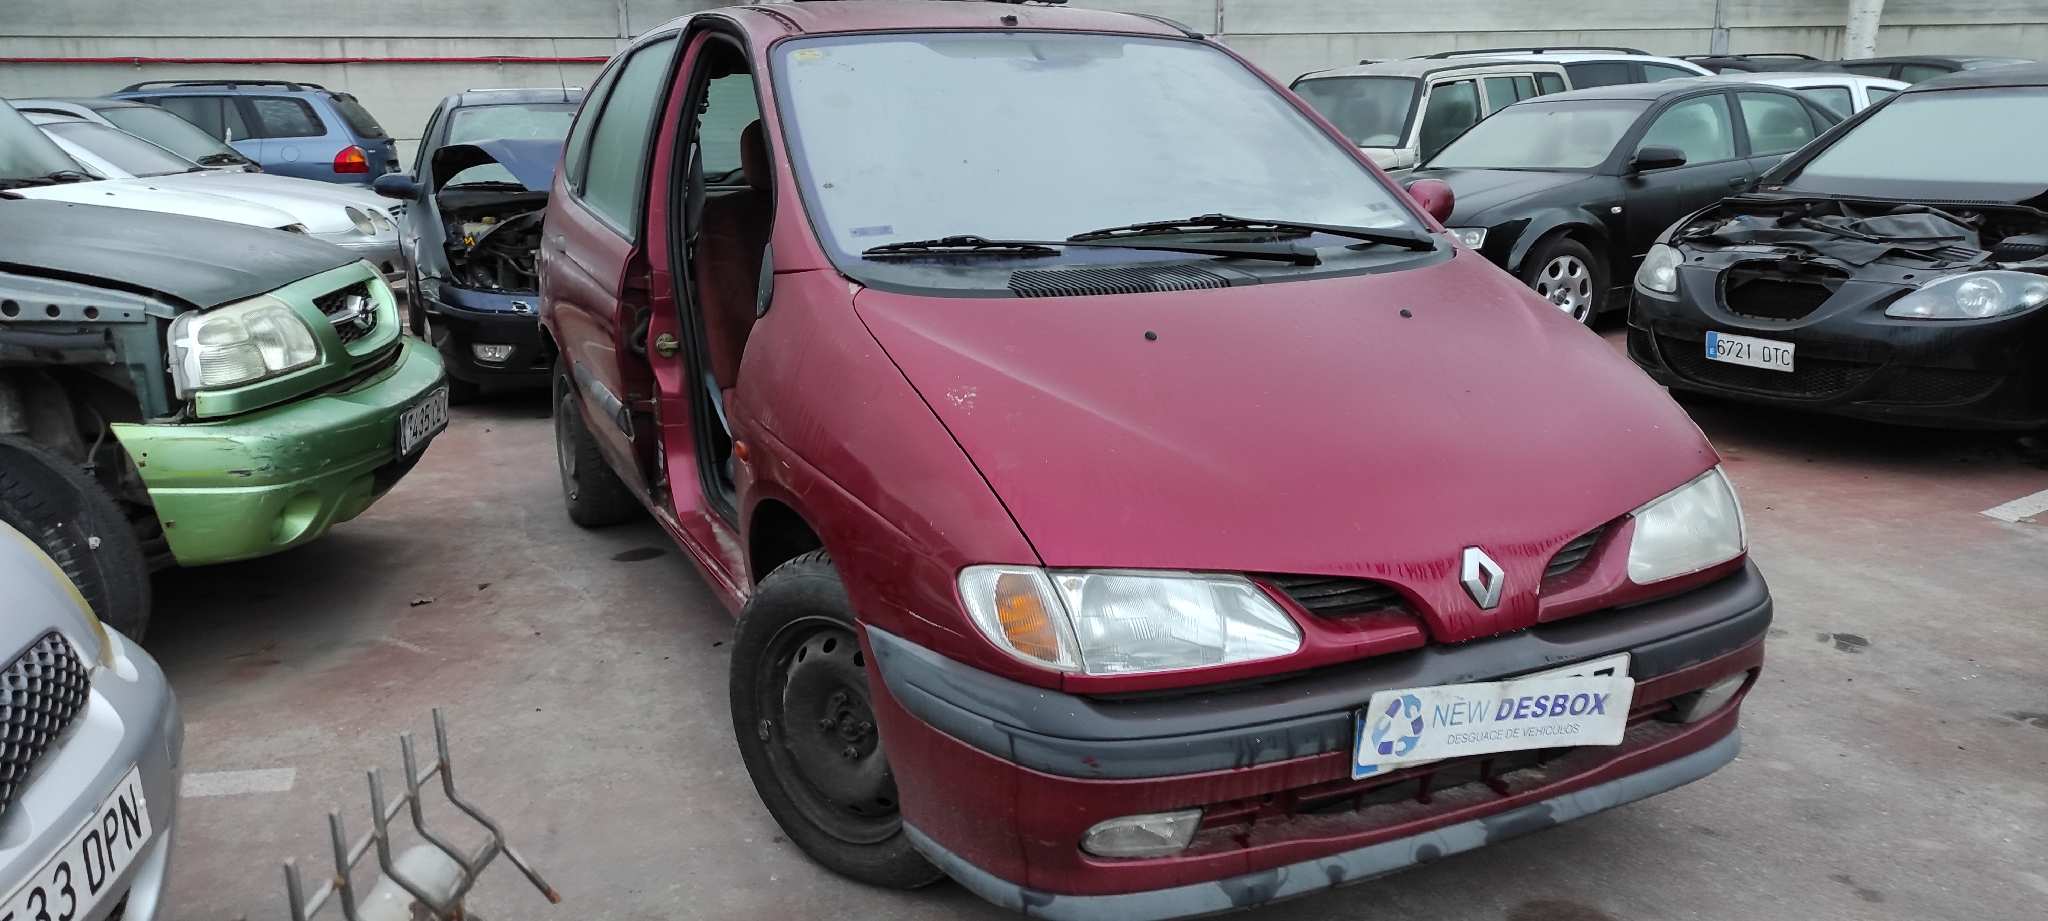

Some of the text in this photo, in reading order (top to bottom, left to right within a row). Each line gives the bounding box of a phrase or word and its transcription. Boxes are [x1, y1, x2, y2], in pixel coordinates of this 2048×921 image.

[1717, 340, 1791, 366] 6721 DTC
[1432, 692, 1611, 729] NEW DESBOX
[1447, 728, 1503, 745] DESGUACE
[1505, 727, 1520, 740] DE
[0, 783, 143, 921] 33 DPN
